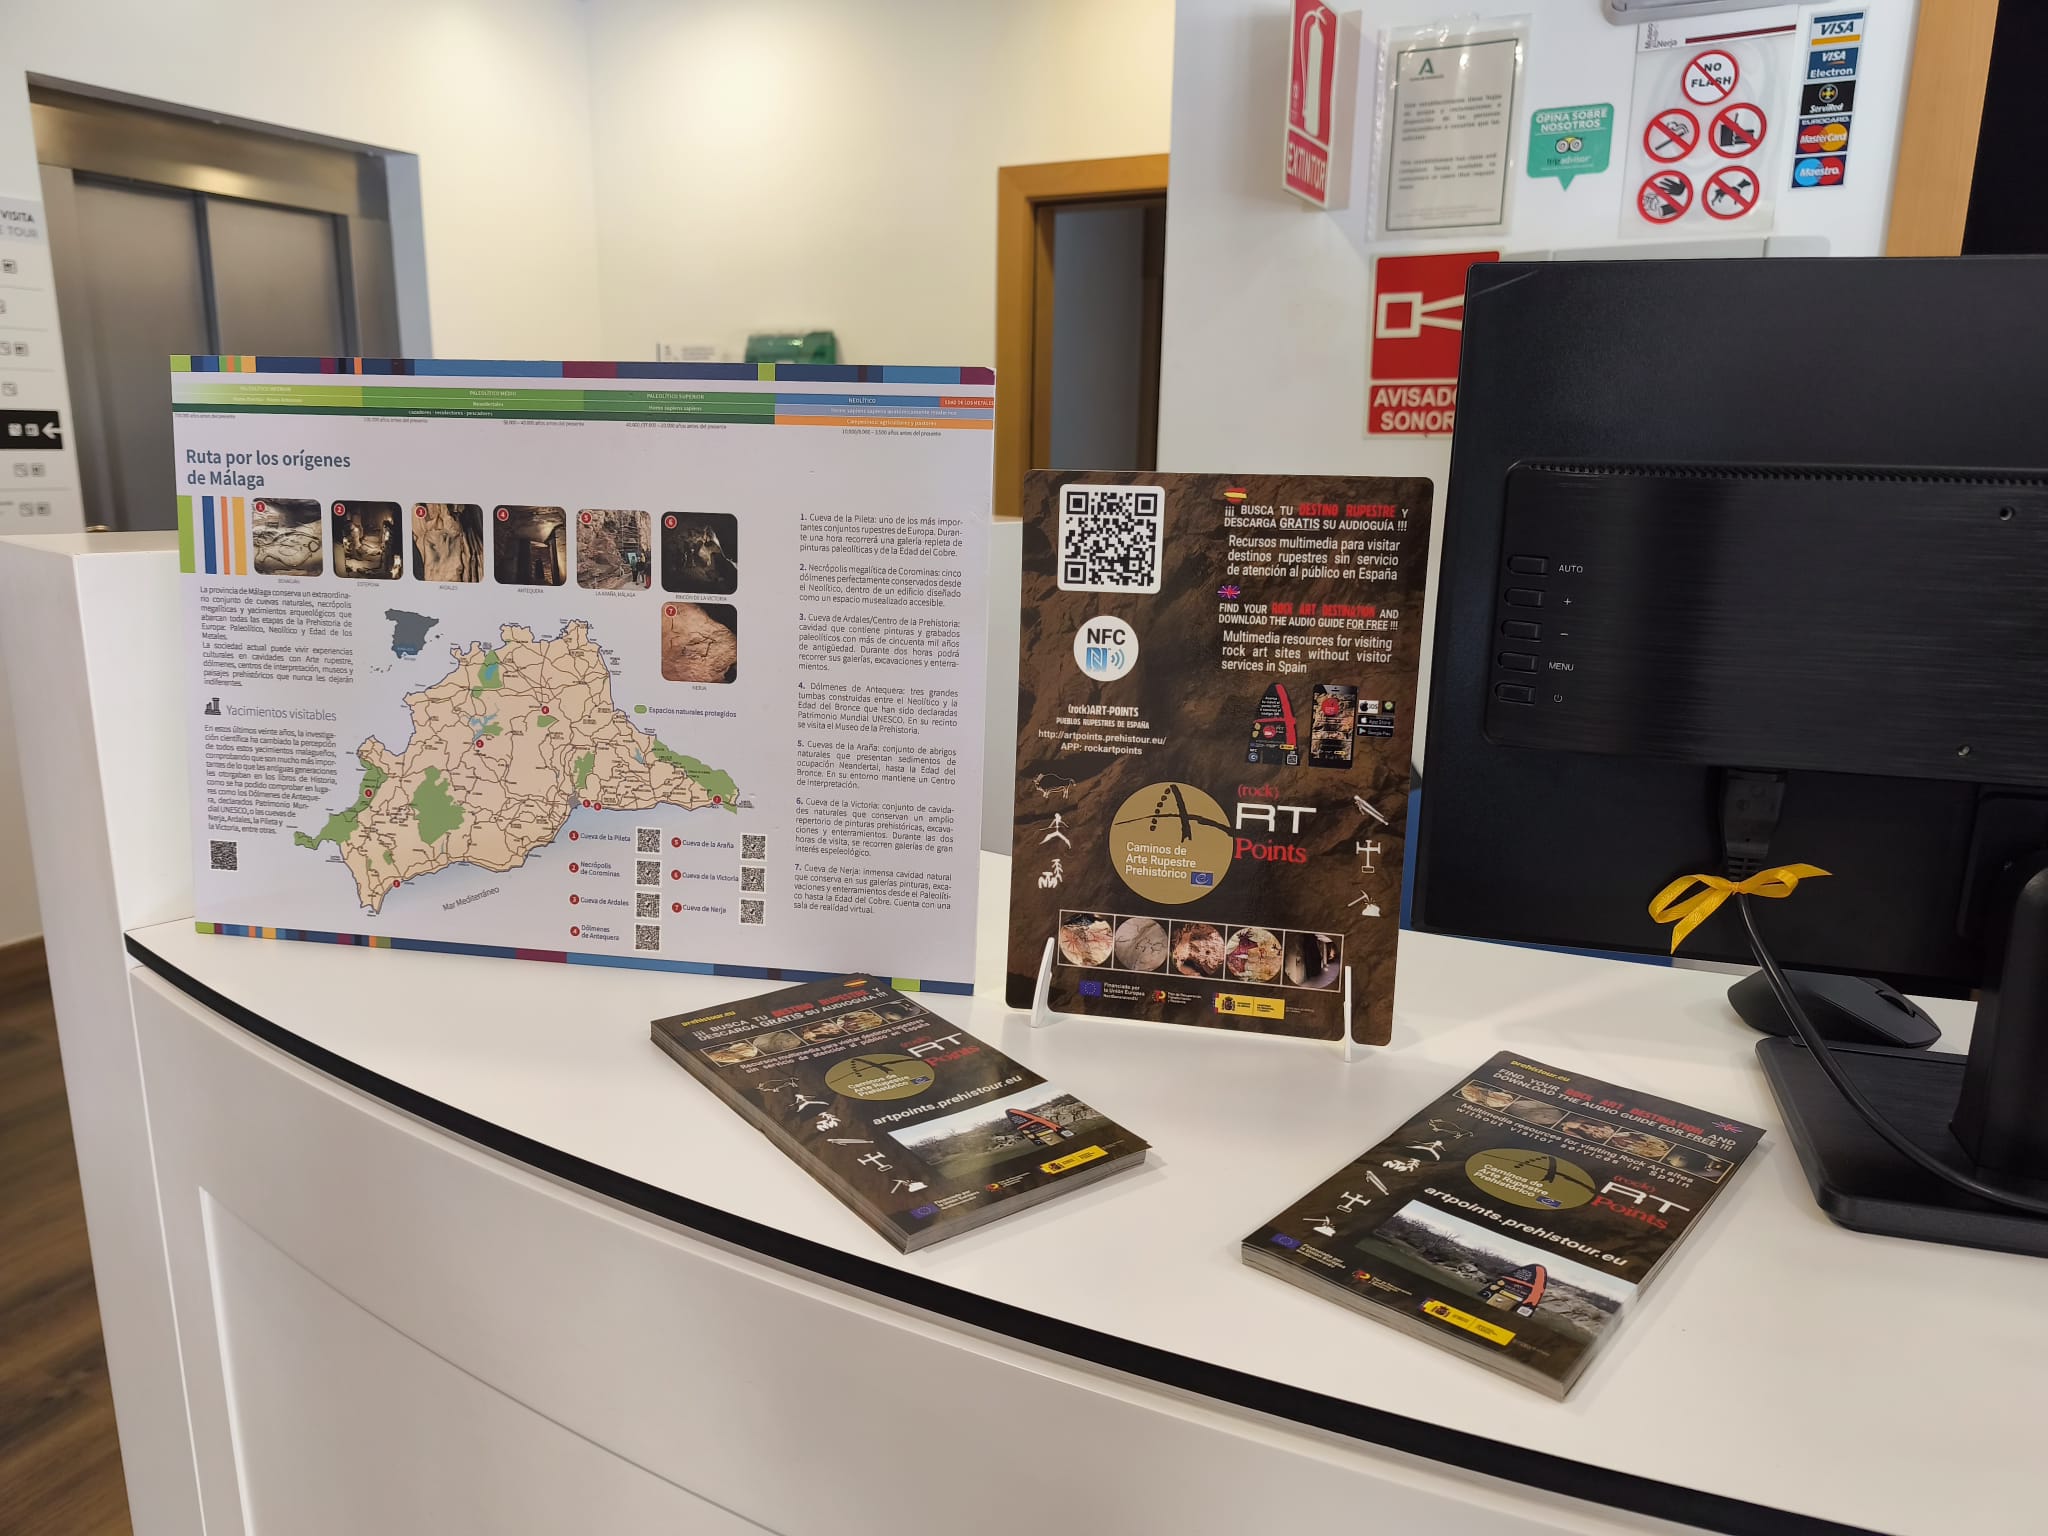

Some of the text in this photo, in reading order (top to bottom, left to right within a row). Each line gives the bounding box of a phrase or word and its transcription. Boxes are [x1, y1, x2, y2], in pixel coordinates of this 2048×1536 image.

[1821, 21, 1854, 36] VISA
[1822, 51, 1846, 62] VISA
[1704, 62, 1722, 72] NO
[1810, 67, 1853, 78] Electron
[1809, 102, 1844, 113] ServiRed
[1535, 108, 1608, 124] OPINA SOBRE
[1802, 116, 1850, 125] EUROCARD
[1540, 118, 1601, 131] NOSOTROS
[1800, 131, 1848, 143] MasterCard
[1287, 142, 1326, 193] EXTINTOR
[1800, 165, 1840, 177] Maestro
[186, 449, 351, 471] Ruta por los orígenes
[187, 470, 265, 490] de Málaga
[1241, 505, 1273, 515] BUSCA
[1280, 506, 1293, 515] TU
[1299, 504, 1338, 516] DESTINO
[1346, 505, 1395, 517] RUPESTRE
[1402, 509, 1408, 518] Y
[810, 514, 832, 522] Cueva
[896, 516, 905, 524] de
[907, 517, 918, 525] los
[920, 517, 935, 525] más
[938, 518, 963, 526] impor-
[1224, 518, 1407, 531] DESCARGA GRATIS SU AUDIOGUÍA !!!
[1229, 535, 1400, 552] Recursos multimedia para visitar
[1228, 550, 1398, 566] destinos rupestres sin servicio
[1227, 564, 1397, 582] de atención al público en España
[1558, 564, 1583, 573] AUTO
[1219, 603, 1239, 612] FIND
[1244, 604, 1267, 613] YOUR
[1300, 603, 1316, 616] ART
[1323, 604, 1375, 617] DESTINATION
[1380, 609, 1399, 618] AND
[1219, 615, 1398, 630] DOWNLOAD THE AUDIO GUIDE FOR FREE !!!
[1087, 629, 1125, 644] NFC
[1224, 631, 1392, 651] Multimedia resources for visiting
[1222, 645, 1392, 663] rock art sites without visitor
[1222, 660, 1307, 674] services in Spain
[1548, 662, 1574, 671] MENU
[226, 704, 336, 721] Yacimientos visitables
[649, 706, 674, 716] Espacios
[705, 710, 737, 718] protegidos
[1068, 704, 1139, 717] (rock)ART-POINTS
[1056, 717, 1150, 729] PUEBLOS RUPESTRES DE ESPAÑA
[1038, 729, 1167, 745] http://artpoints.prehistour.eu/
[1061, 742, 1143, 756] APP: rockartpoints
[1238, 784, 1279, 799] (rock)
[1127, 842, 1187, 855] Caminos de
[1235, 838, 1307, 862] Points
[1126, 854, 1196, 869] Arte Rupestre
[1125, 865, 1187, 879] Prehistórico
[442, 886, 500, 910] Mar Mediterráneo
[681, 1010, 736, 1027] prehistour.eu
[698, 994, 878, 1041] DESCARGA GRATIS SU AUDIOGUÍA
[709, 1020, 749, 1032] BUSCA
[1510, 1060, 1571, 1082] prehistour.eu
[848, 1074, 898, 1090] Caminos de
[854, 1074, 910, 1094] Arte Rupestre
[858, 1082, 908, 1097] Prehistórico
[873, 1074, 1022, 1126] artpoints.prehistour.eu
[1498, 1068, 1525, 1081] FIND
[1529, 1079, 1560, 1092] YOUR
[1707, 1134, 1736, 1146] AND
[1493, 1073, 1718, 1148] DOWNLOAD THE AUDIO GUIDE FOR FREE
[1478, 1169, 1549, 1196] Arte Rupestre
[1483, 1164, 1544, 1188] Caminos de
[1473, 1172, 1537, 1197] Prehistórico
[1591, 1196, 1668, 1229] Points
[1424, 1186, 1628, 1267] artpoints.prehistour.eu
